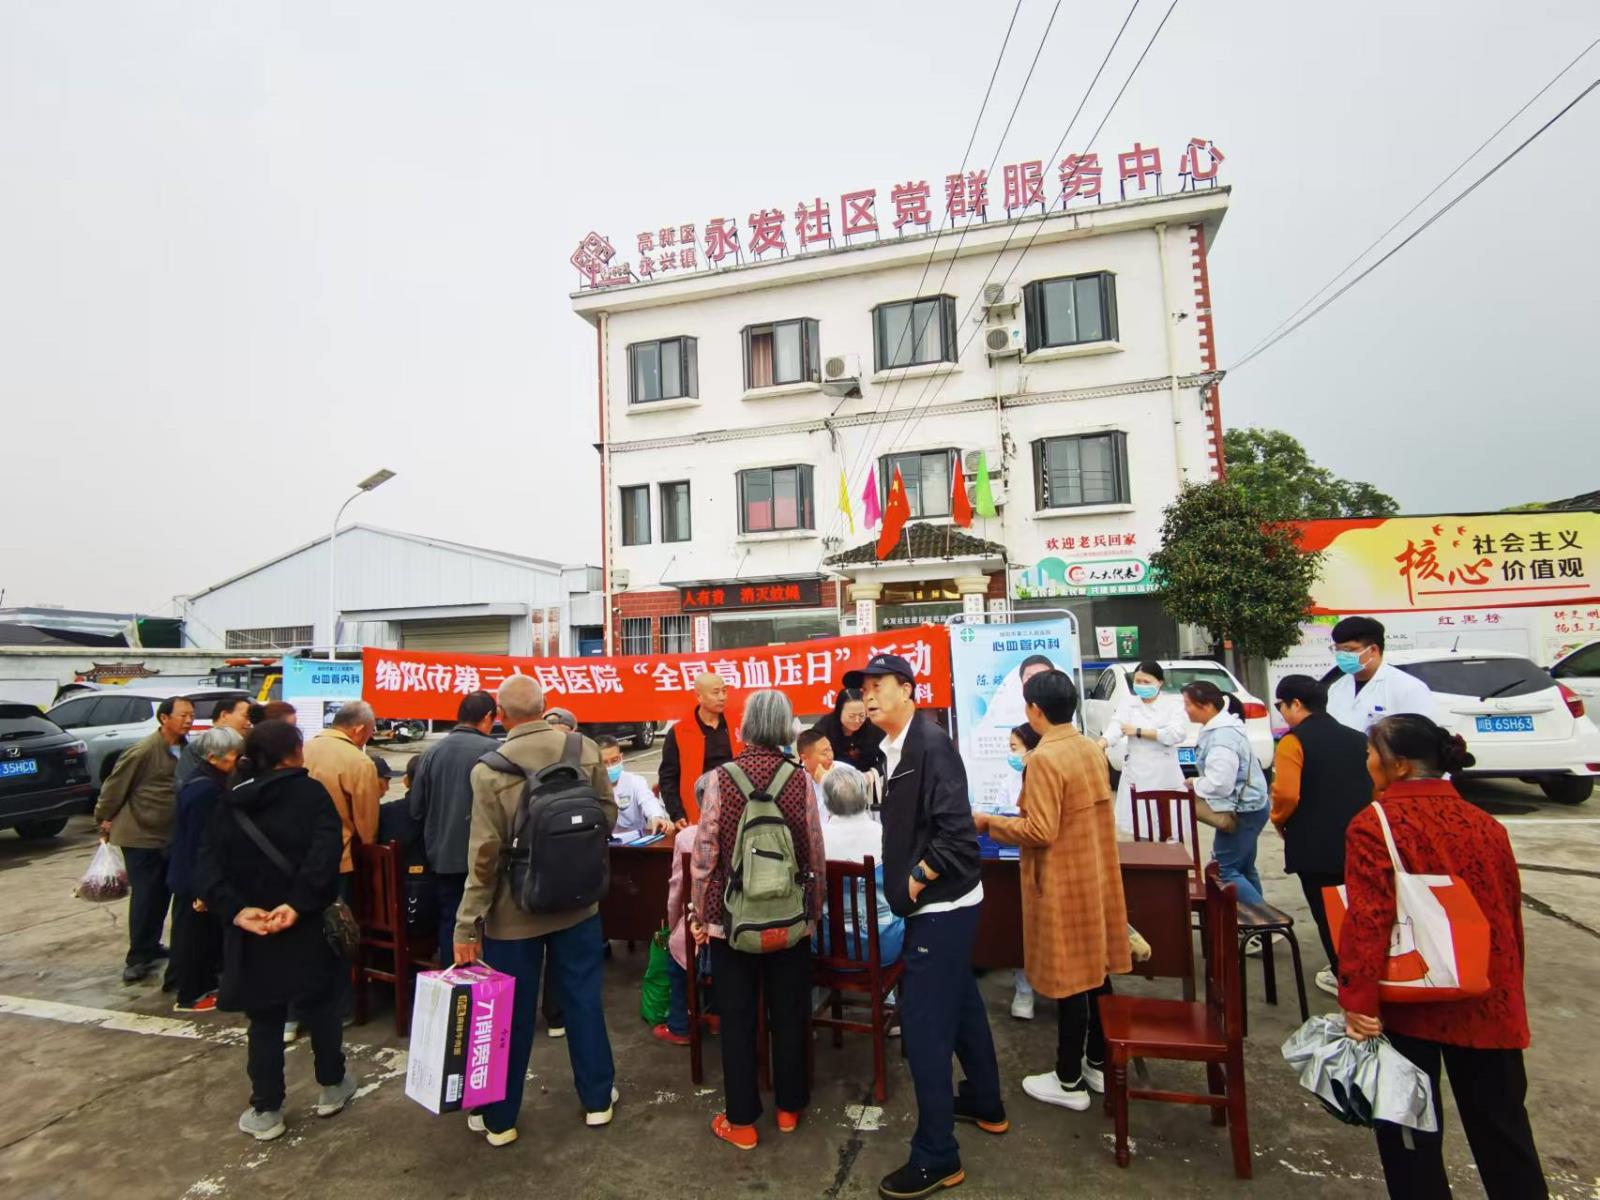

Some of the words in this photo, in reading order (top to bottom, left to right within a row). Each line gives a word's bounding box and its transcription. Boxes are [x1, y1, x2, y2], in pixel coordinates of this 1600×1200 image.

[704, 137, 1225, 262] 永发社区党群服务中心
[637, 224, 695, 253] 高新区
[640, 247, 698, 276] 永兴镇
[1046, 533, 1137, 551] 欢迎老兵回家
[1472, 530, 1583, 555] 社会主义
[1089, 566, 1137, 580] 人大代表
[1395, 539, 1493, 606] 核心
[1501, 557, 1585, 582] 价值观
[992, 638, 1060, 651] 心血管内科
[311, 674, 360, 684] 心血管内科
[470, 999, 494, 1089] 刀削宽面
